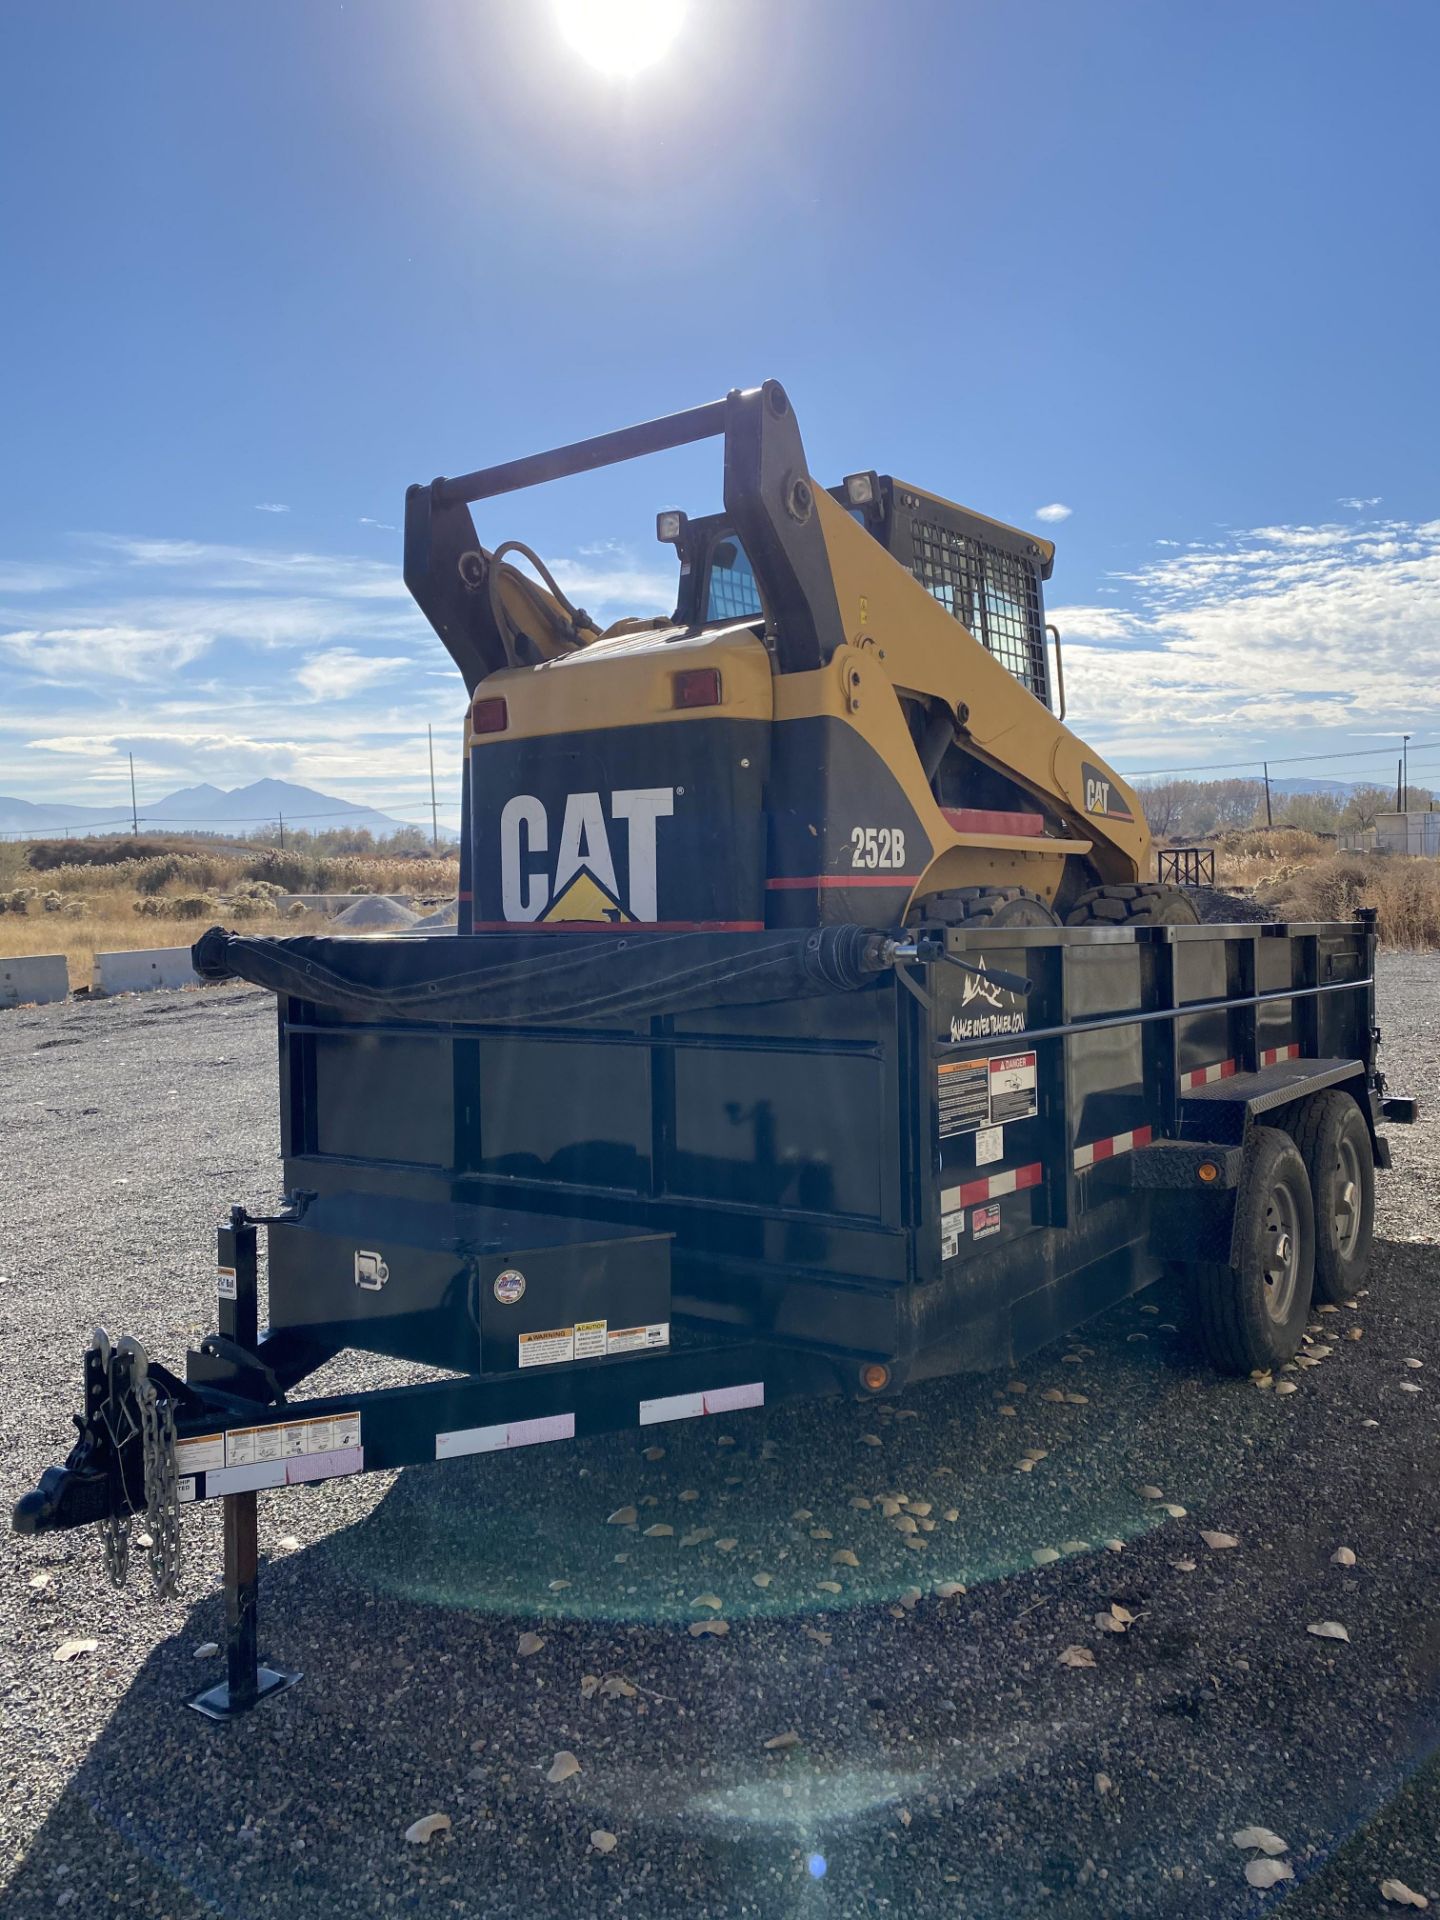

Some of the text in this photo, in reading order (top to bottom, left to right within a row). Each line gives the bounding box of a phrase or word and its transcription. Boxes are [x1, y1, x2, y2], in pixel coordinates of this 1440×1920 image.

[1087, 779, 1109, 814] CAT
[500, 787, 674, 923] CAT
[851, 826, 906, 869] 252B
[1005, 1057, 1027, 1069] DANGER
[532, 1330, 566, 1342] WARNING
[581, 1323, 605, 1332] CAUTION
